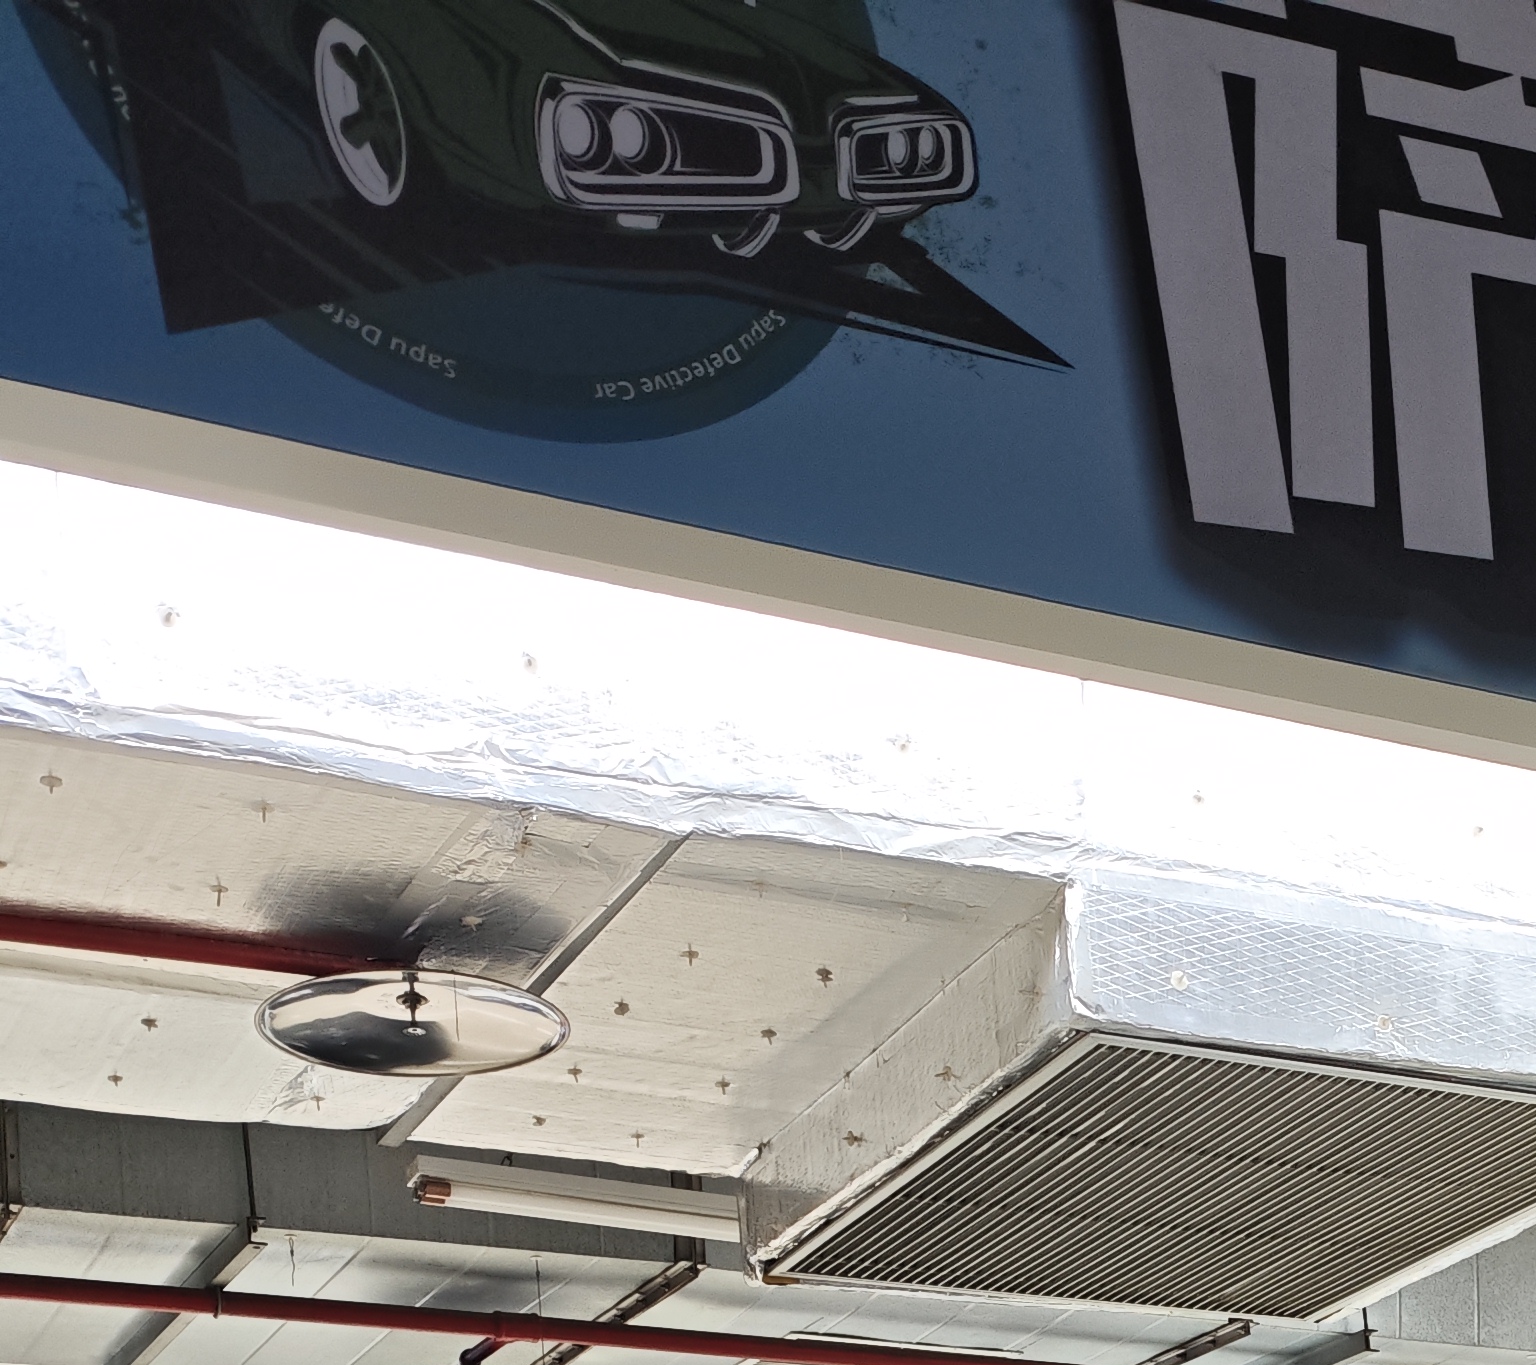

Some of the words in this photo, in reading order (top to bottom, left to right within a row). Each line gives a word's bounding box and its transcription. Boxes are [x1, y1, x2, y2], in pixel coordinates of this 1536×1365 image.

[737, 309, 787, 351] Sapu
[389, 335, 457, 379] Sapu
[639, 343, 743, 393] Defective
[594, 380, 636, 401] Car
